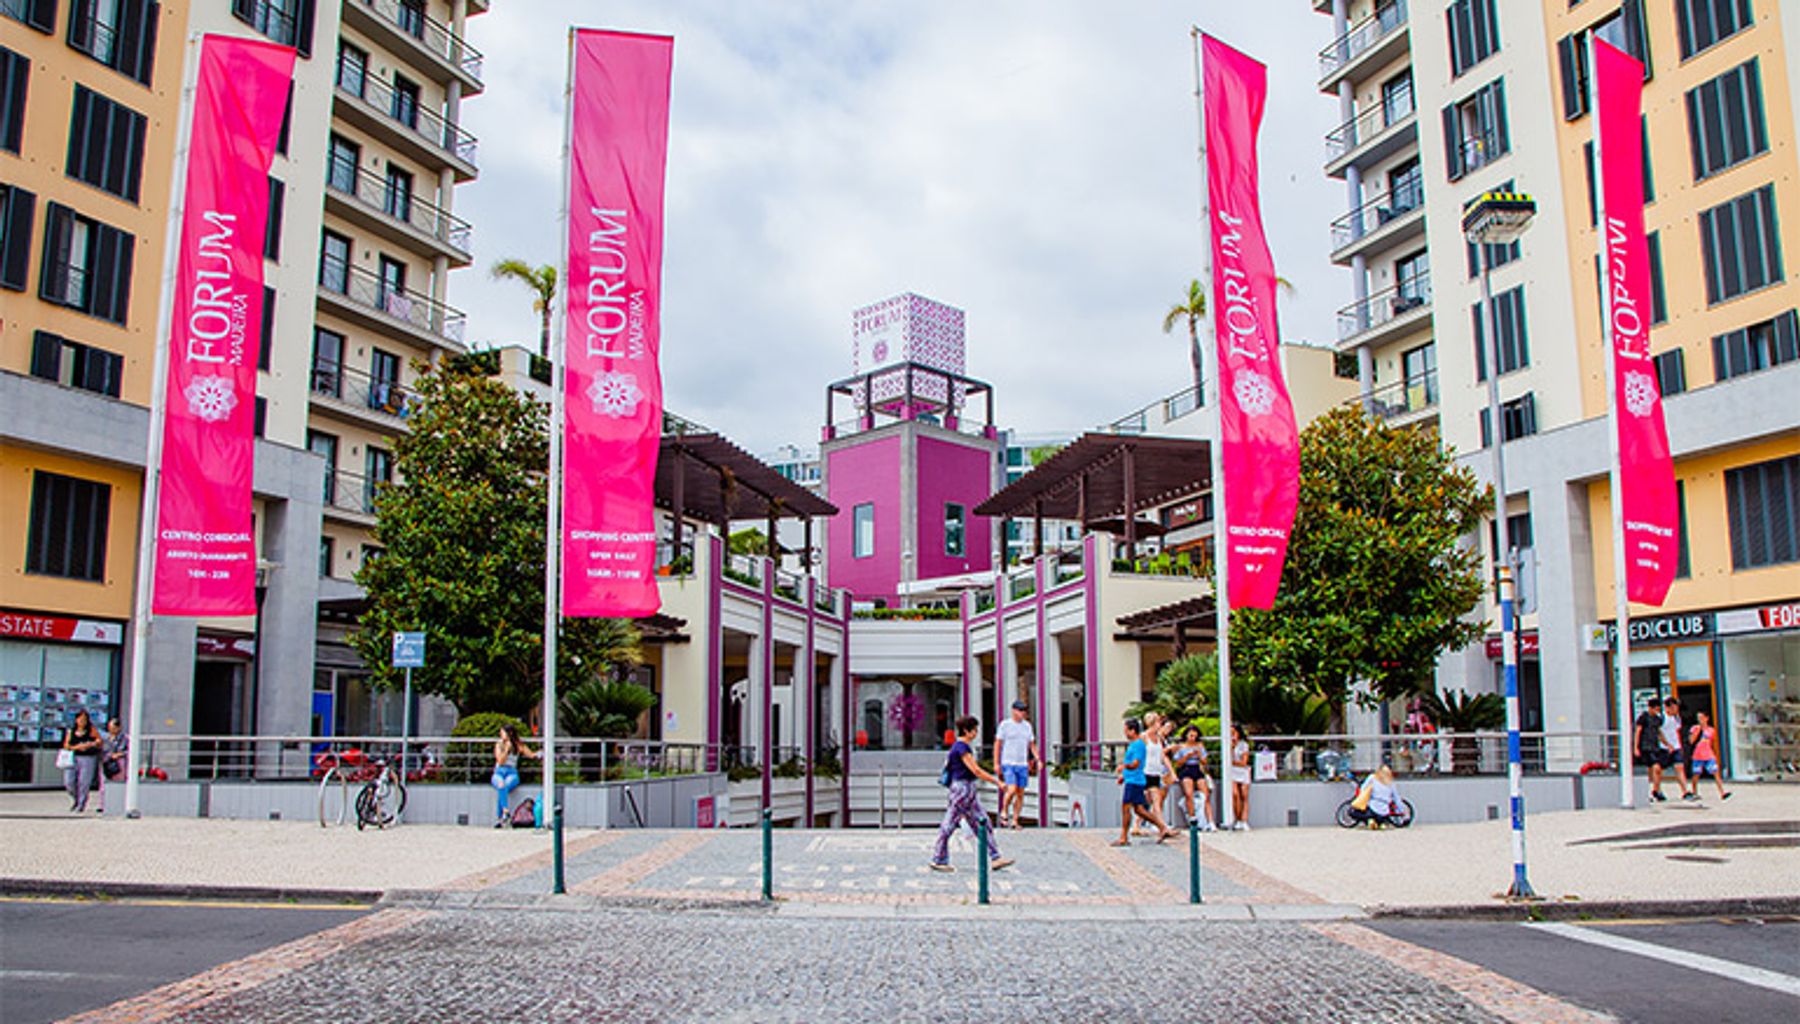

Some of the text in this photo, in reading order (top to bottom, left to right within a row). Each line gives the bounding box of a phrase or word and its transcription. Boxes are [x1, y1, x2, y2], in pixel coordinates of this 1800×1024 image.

[186, 210, 237, 363] FORUM
[586, 207, 628, 359] FORUM
[229, 294, 249, 366] MADEIRA
[628, 289, 645, 360] MADEIRA
[161, 530, 202, 542] CENTRO
[1, 615, 54, 637] STATE
[1608, 617, 1704, 642] PEDICLUB
